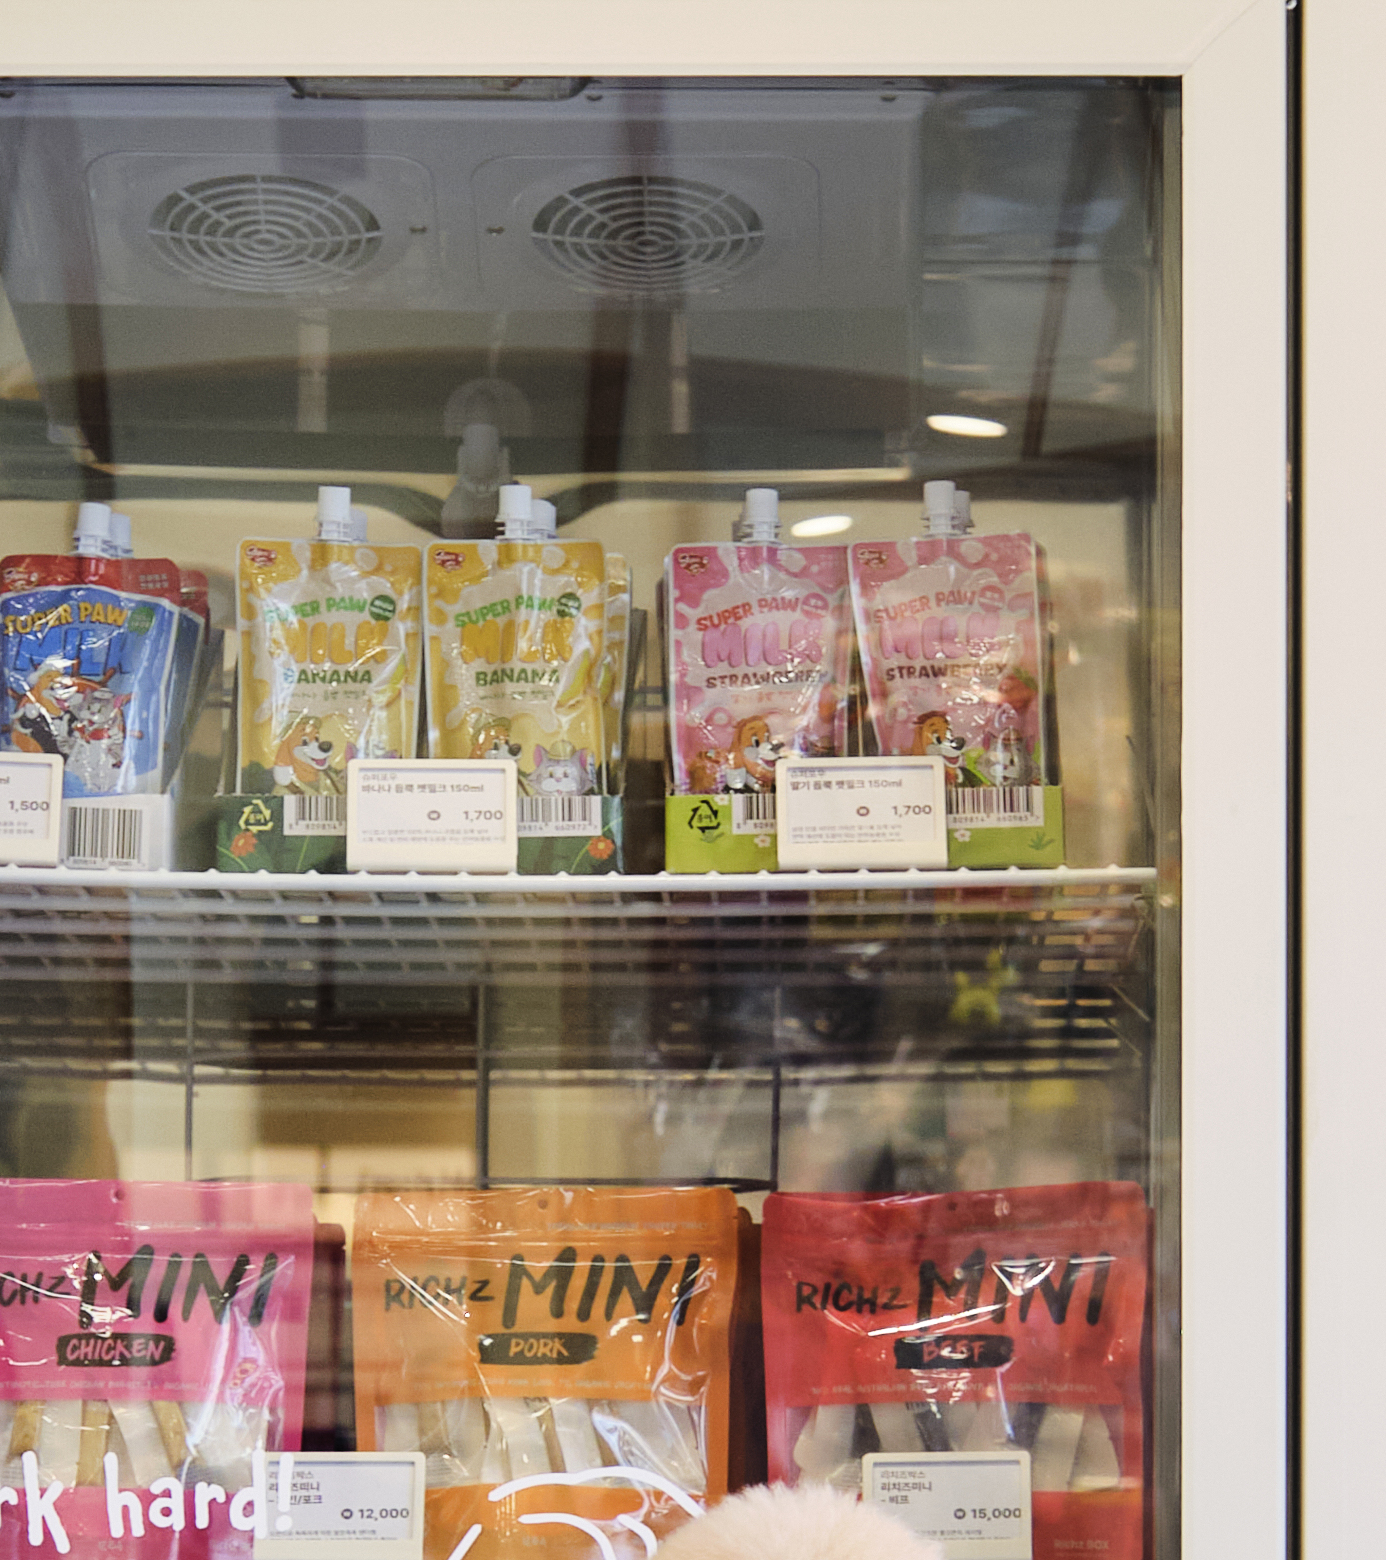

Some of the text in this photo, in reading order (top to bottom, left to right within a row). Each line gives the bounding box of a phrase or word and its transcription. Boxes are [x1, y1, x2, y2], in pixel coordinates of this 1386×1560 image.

[4, 601, 128, 636] SUPER PAW
[265, 596, 368, 623] SUPER PAW
[454, 594, 555, 628] SUPER PAW
[696, 596, 800, 632] SUPER PAW
[873, 590, 977, 625] SUPER PAW
[15, 624, 130, 674] MILK
[702, 619, 822, 668] MILK
[283, 668, 373, 686] BANANA
[475, 668, 560, 687] BANANA
[705, 671, 827, 689] STRAWBERRY
[885, 663, 1008, 682] STRAWBERRY
[868, 779, 902, 788] 150ml
[8, 800, 49, 813] 1,500
[463, 810, 503, 822] 1,700
[892, 805, 932, 818] 1,700
[79, 1244, 278, 1330] MINI
[384, 1246, 701, 1329] RICHZ MINI
[796, 1247, 1111, 1332] RICHZ MINI
[65, 1338, 165, 1361] CHICKEN
[508, 1338, 569, 1358] PORK
[104, 1449, 294, 1540] hard!
[358, 1507, 409, 1521] 12,000
[971, 1507, 1022, 1521] 15,000
